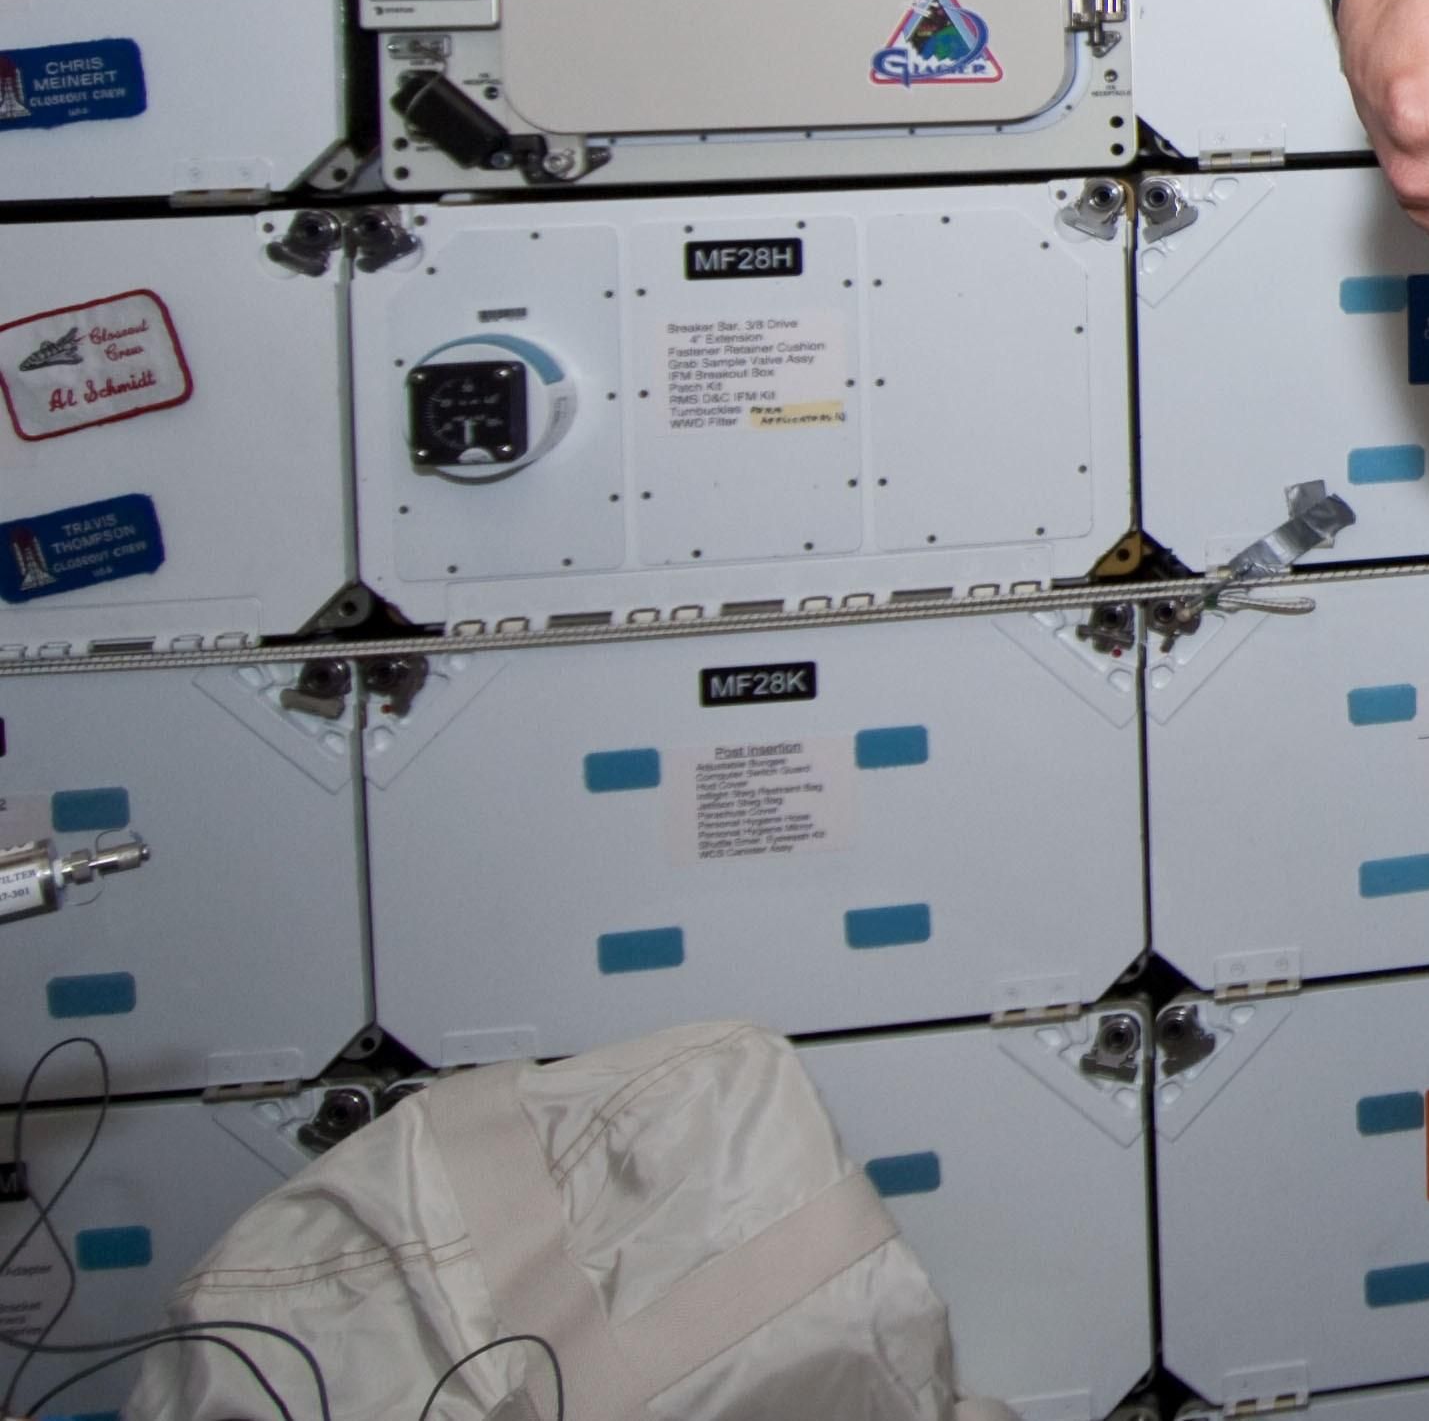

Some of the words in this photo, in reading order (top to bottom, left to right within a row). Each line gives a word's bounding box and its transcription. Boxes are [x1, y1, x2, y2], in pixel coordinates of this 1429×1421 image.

[45, 56, 105, 76] CHRIS
[33, 70, 118, 93] MEINERT
[93, 87, 127, 101] CREW
[693, 246, 794, 272] MF28H
[89, 318, 150, 345] Closeout
[667, 322, 714, 335] Breaker
[767, 318, 799, 330] Drive
[705, 332, 764, 345] Extension
[104, 343, 145, 363] Crew
[667, 346, 721, 358] Fastener
[723, 343, 774, 356] Retainer
[775, 340, 827, 354] Cushion
[668, 358, 699, 371] Grab
[702, 356, 747, 370] Sample
[749, 354, 784, 366] Valve
[785, 353, 816, 366] Assy
[694, 369, 749, 381] Breakout
[751, 367, 776, 378] Box
[48, 388, 78, 413] Al
[83, 368, 157, 405] Schmidt
[668, 382, 703, 394] Patch
[705, 380, 724, 392] Kit
[701, 392, 731, 404] D&C
[759, 389, 777, 401] Kit
[669, 404, 743, 417] Turnbuckles
[708, 415, 739, 427] Filter
[61, 511, 118, 538] TRAVIS
[51, 523, 137, 555] THOMPSON
[112, 540, 148, 558] CREW
[710, 669, 808, 700] MF28K
[714, 746, 744, 760] Post
[746, 741, 803, 759] Insertion
